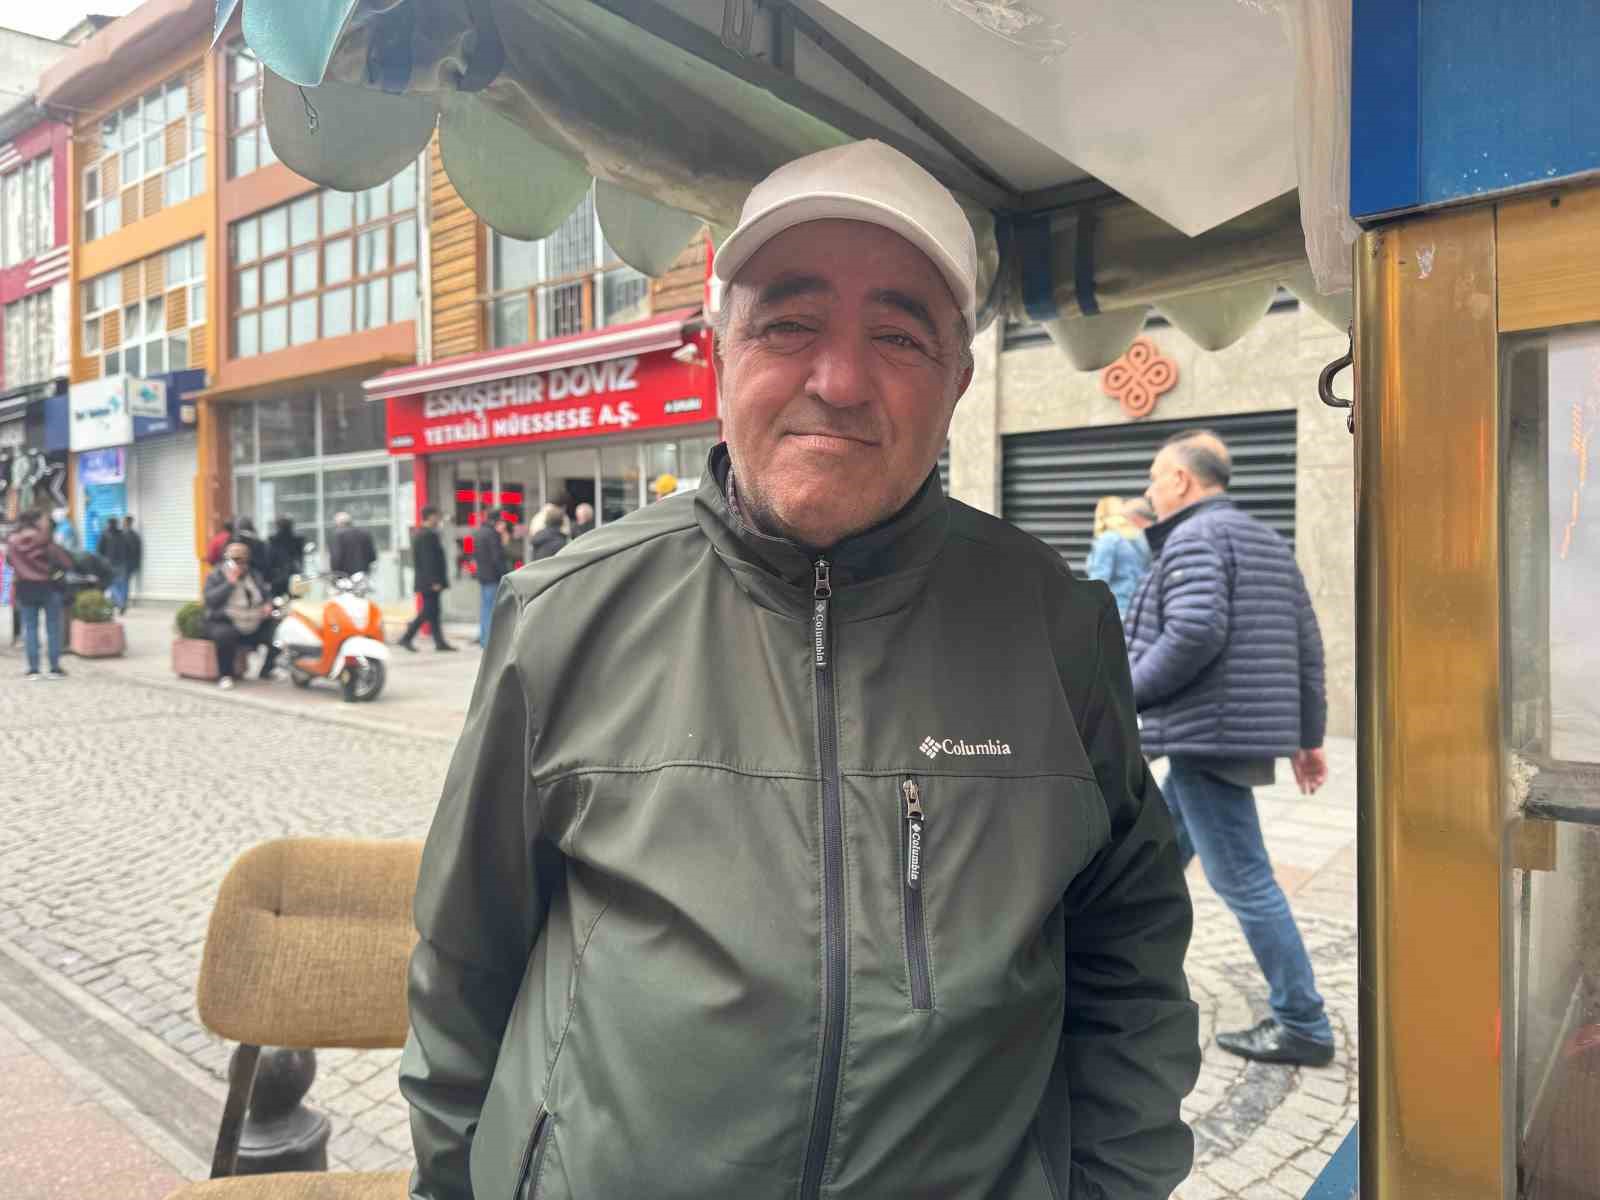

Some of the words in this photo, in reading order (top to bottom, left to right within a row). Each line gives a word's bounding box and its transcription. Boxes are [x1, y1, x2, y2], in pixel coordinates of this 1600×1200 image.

[492, 406, 593, 438] MÜESSESE
[598, 401, 639, 428] A.Ş.
[815, 614, 825, 662] Columbia
[942, 738, 1012, 756] Columbia
[911, 832, 921, 881] Columbia
